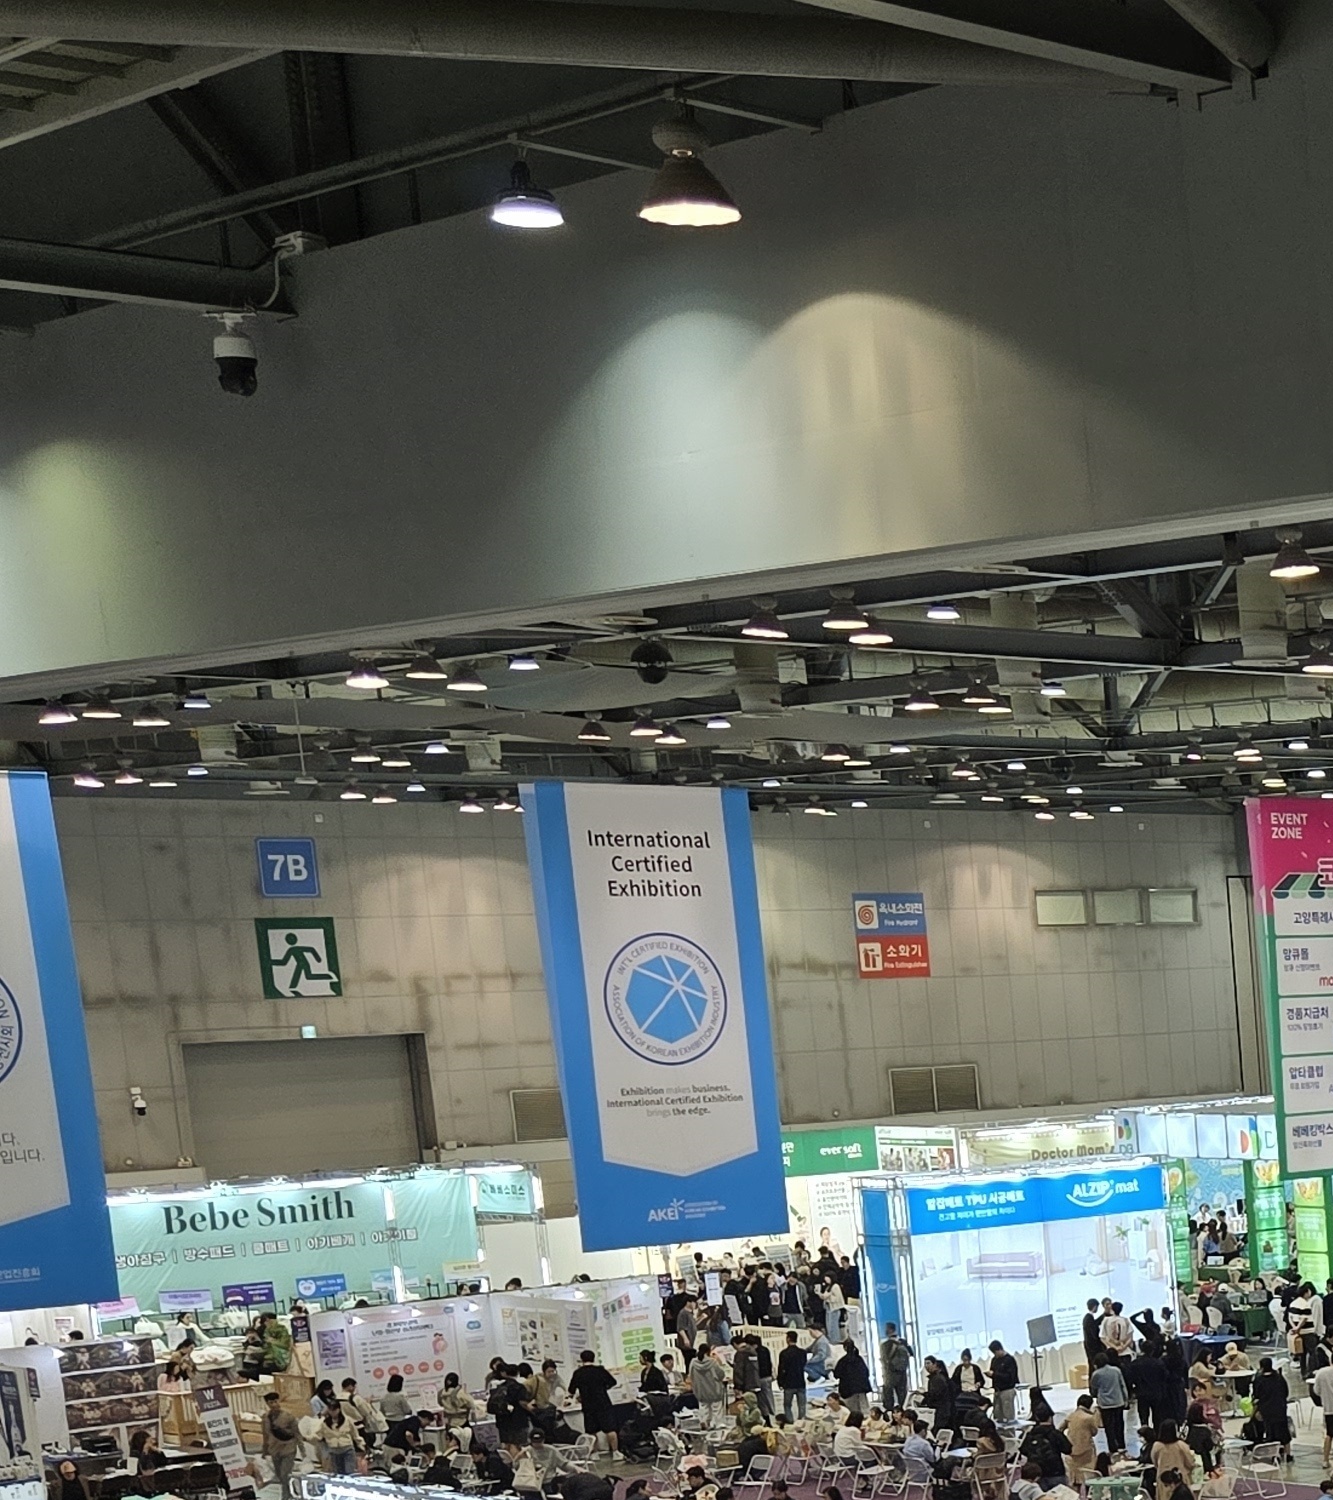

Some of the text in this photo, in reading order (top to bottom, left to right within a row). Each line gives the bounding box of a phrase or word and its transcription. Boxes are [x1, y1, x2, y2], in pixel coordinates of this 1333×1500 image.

[1270, 813, 1308, 825] EVENT
[587, 829, 711, 849] International
[1272, 827, 1302, 839] ZONE
[266, 853, 308, 882] 7B
[611, 855, 693, 873] Certified
[608, 879, 702, 897] Exhibition
[879, 903, 923, 914] 옥내소화전
[887, 944, 922, 957] 소화기
[631, 941, 710, 975] CERTIFIED EXHIBITION
[1286, 1006, 1329, 1020] 경품지급처
[1289, 1065, 1324, 1080] 압타클럽
[620, 1087, 665, 1097] Exhibition
[692, 1084, 731, 1093] business.
[607, 1094, 744, 1108] International Certified Exhibition
[672, 1107, 686, 1115] the
[688, 1107, 711, 1116] edge.
[1031, 1147, 1074, 1161] Doctor
[1073, 1178, 1140, 1198] ALZIP mat
[164, 1190, 355, 1235] Bebe Smith
